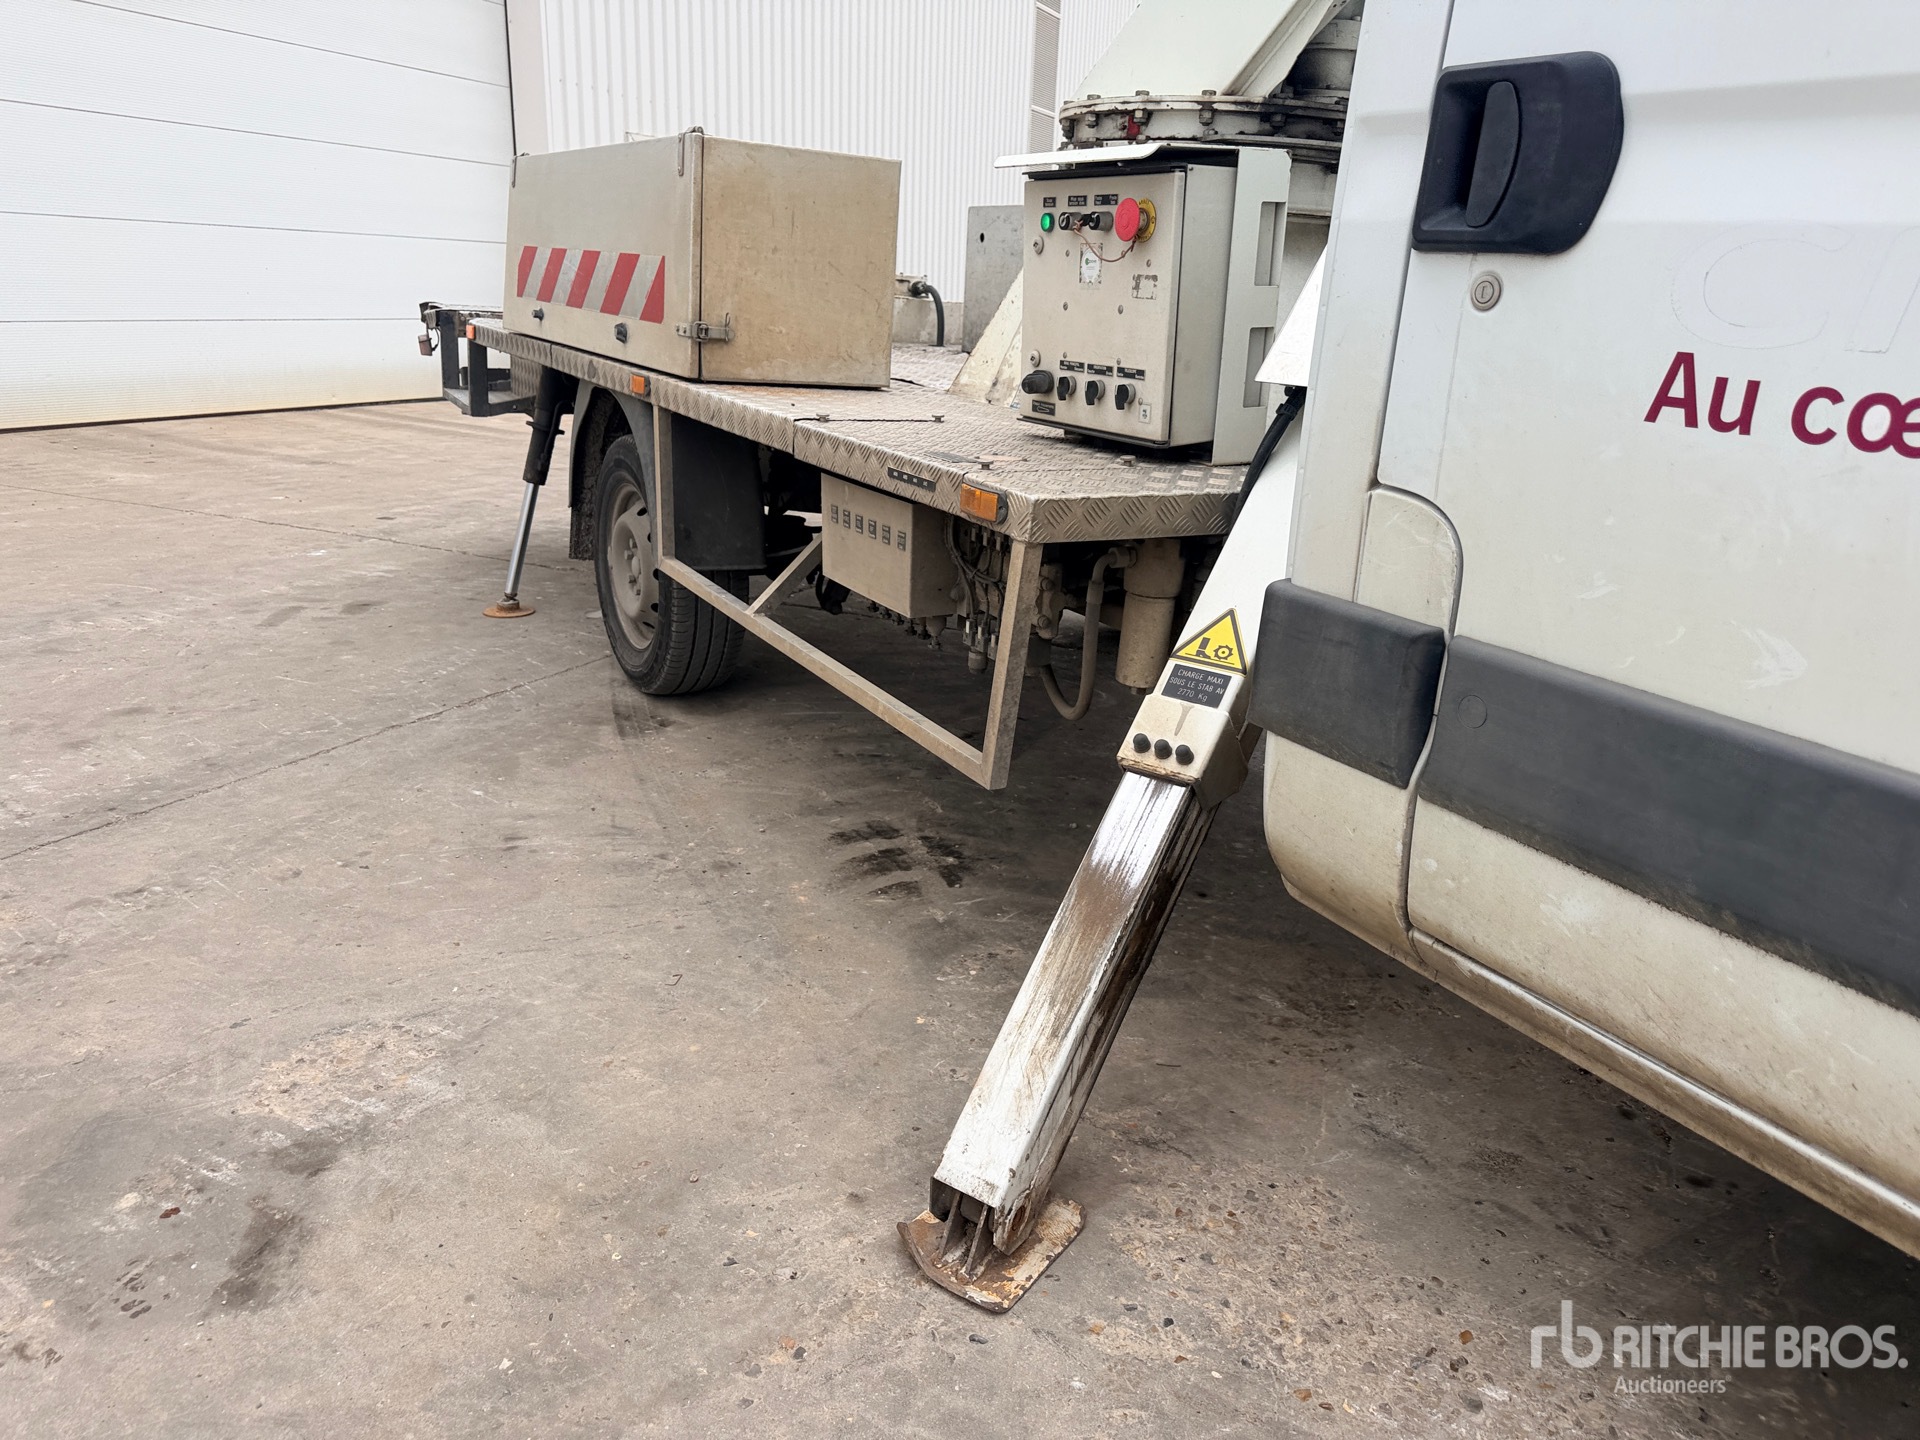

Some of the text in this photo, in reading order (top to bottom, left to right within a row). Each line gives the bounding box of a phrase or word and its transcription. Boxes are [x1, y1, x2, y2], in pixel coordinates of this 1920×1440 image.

[1643, 350, 1761, 436] Au
[1169, 676, 1186, 686] SOUS
[1187, 680, 1196, 688] LE
[1197, 683, 1214, 692] STAB
[1177, 669, 1224, 684] CHARGE MAXI
[1177, 688, 1208, 702] 2770 Kg
